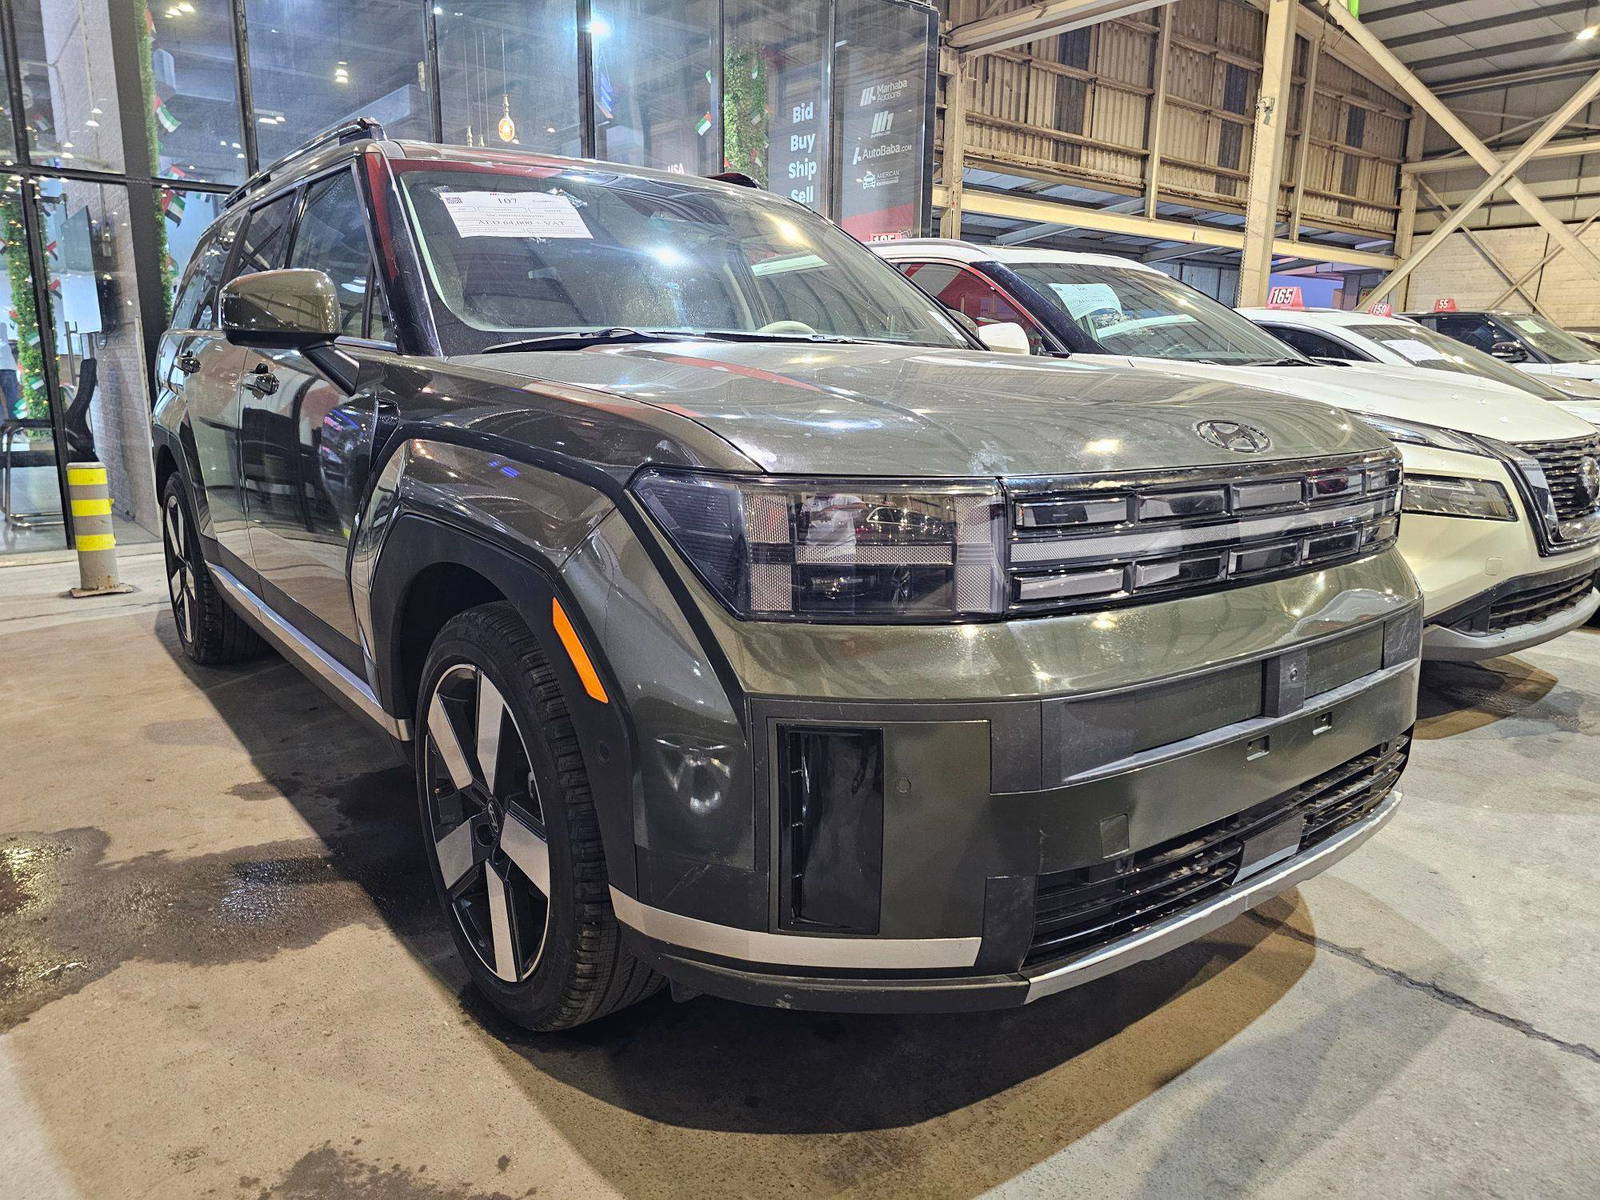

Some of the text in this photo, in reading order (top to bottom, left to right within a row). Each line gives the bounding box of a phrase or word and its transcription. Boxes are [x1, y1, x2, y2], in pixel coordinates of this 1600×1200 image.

[793, 102, 814, 123] Bid
[790, 133, 816, 153] Buy
[1271, 288, 1294, 304] 165
[1439, 299, 1448, 308] 55
[1372, 303, 1386, 315] 150
